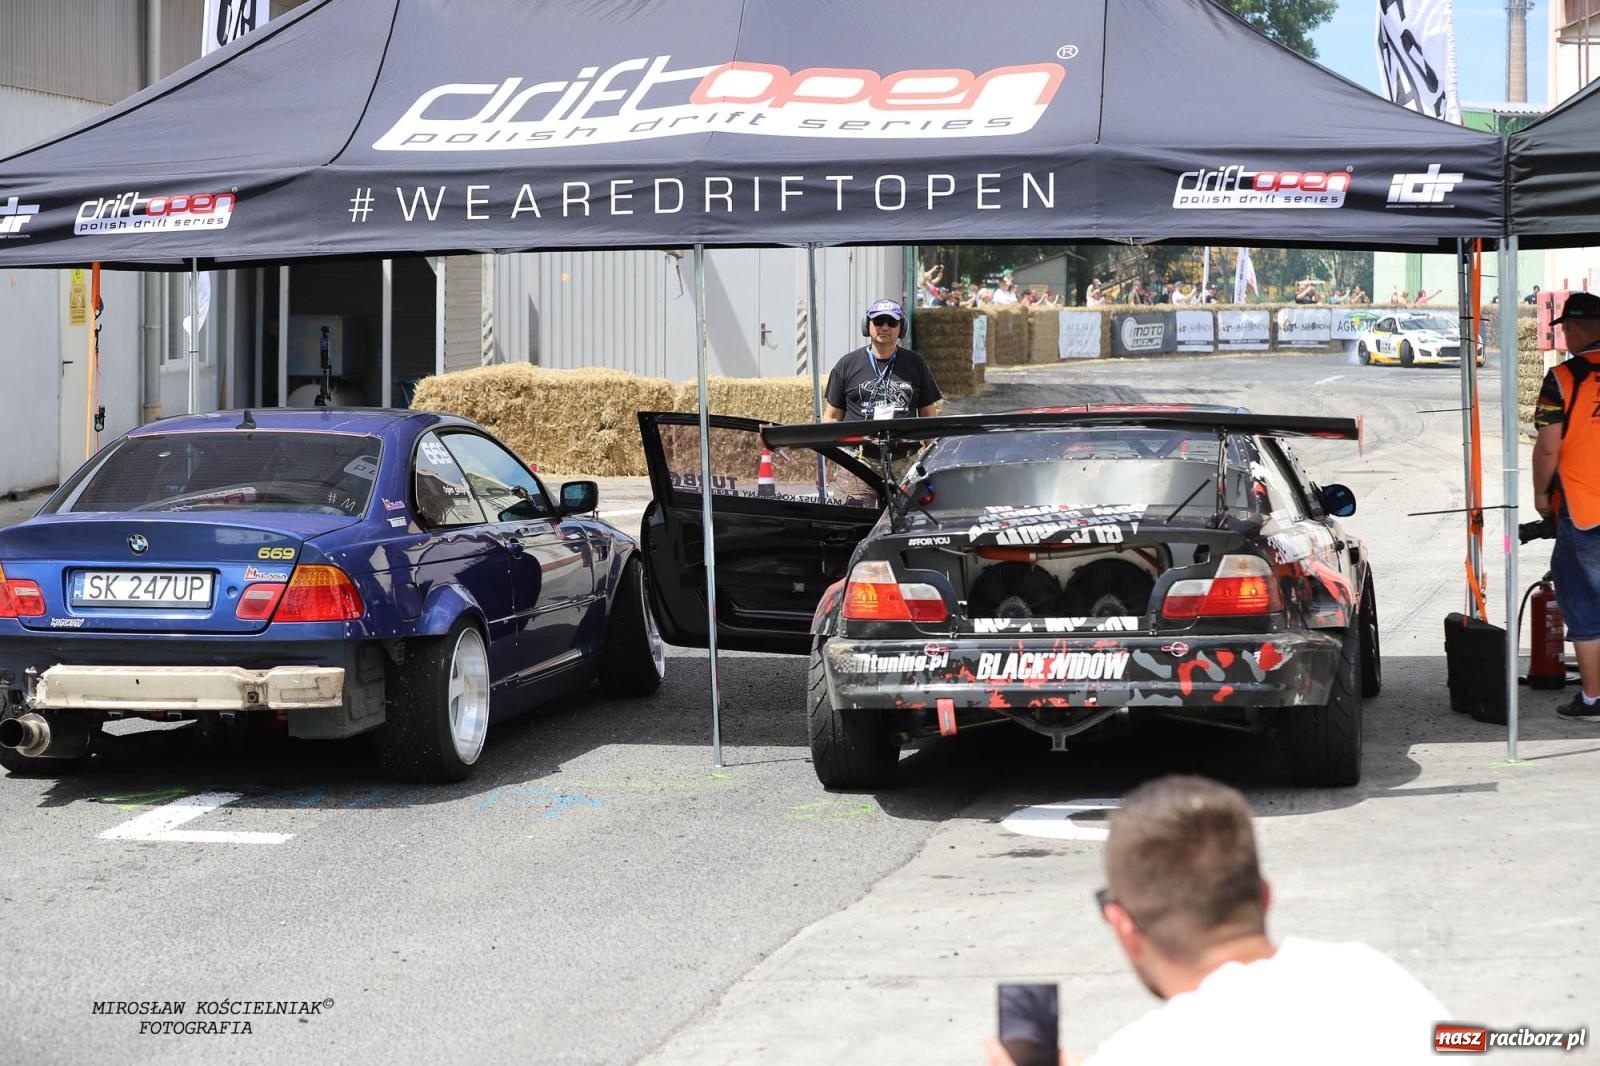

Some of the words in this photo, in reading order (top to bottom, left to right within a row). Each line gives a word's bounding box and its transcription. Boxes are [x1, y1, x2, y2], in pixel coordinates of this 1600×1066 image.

[399, 126, 598, 146] polish
[628, 111, 767, 133] drift
[801, 114, 1014, 132] series
[1179, 194, 1231, 205] polish
[1239, 193, 1276, 204] drift
[1283, 194, 1339, 204] series
[79, 219, 128, 232] polish
[133, 217, 168, 229] drift
[174, 216, 225, 227] series
[932, 536, 951, 546] YOU
[257, 547, 296, 560] 669
[89, 574, 120, 600] SK
[127, 575, 204, 601] 247UP
